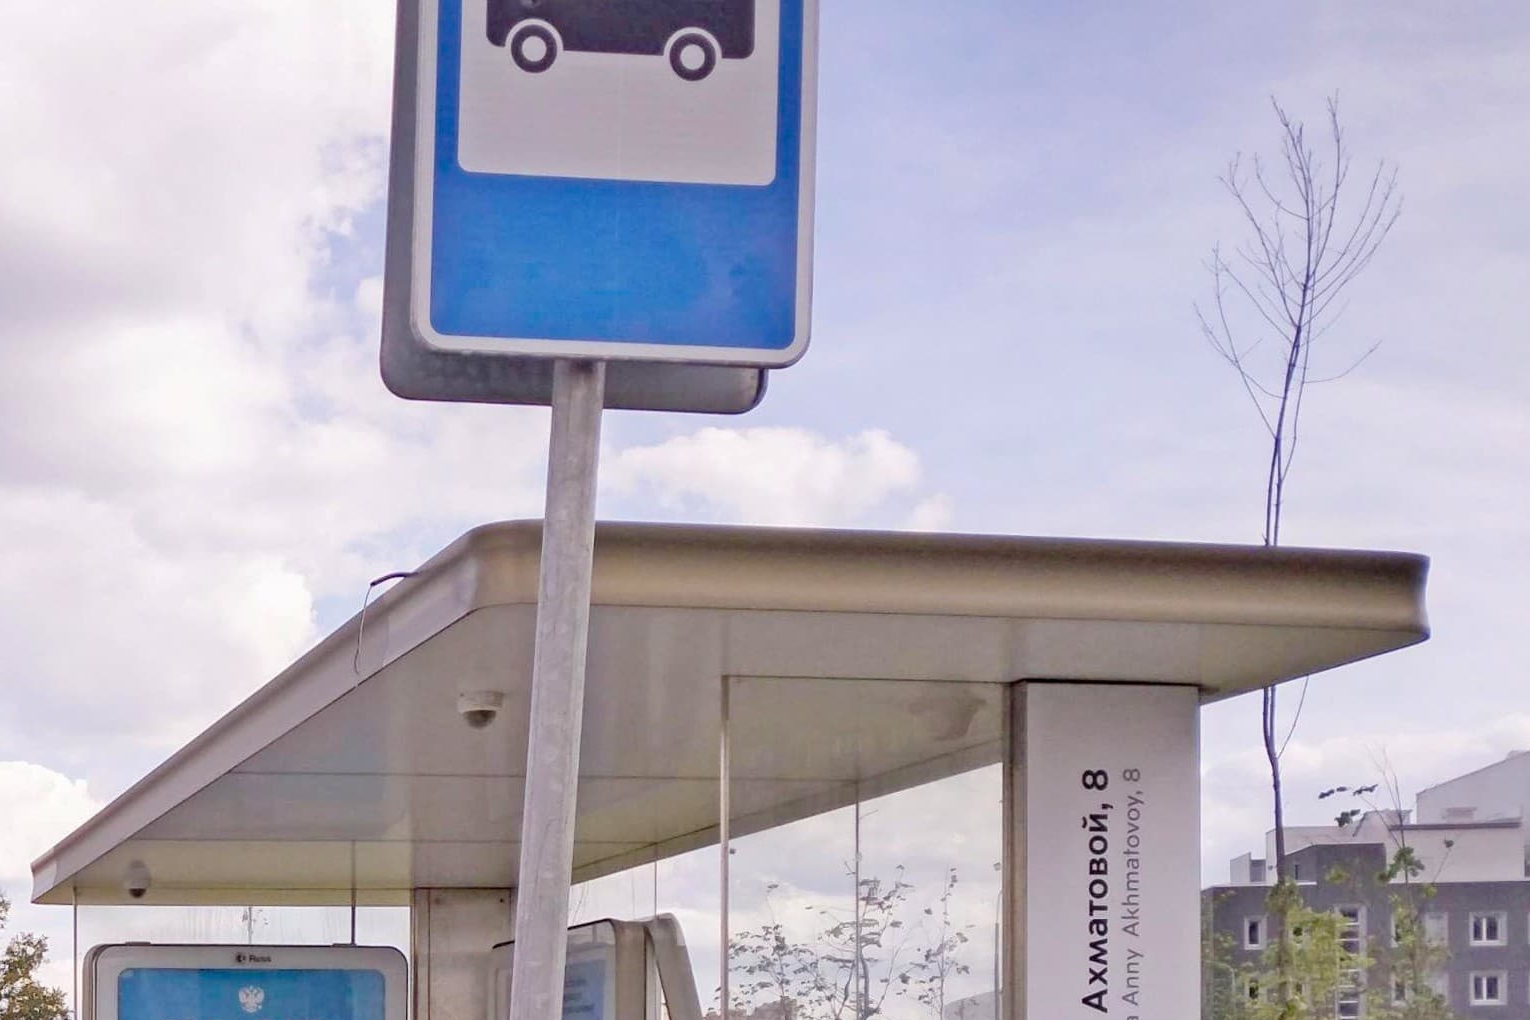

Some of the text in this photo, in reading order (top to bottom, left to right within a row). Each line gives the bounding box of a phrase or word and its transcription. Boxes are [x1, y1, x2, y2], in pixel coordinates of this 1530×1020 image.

[1082, 769, 1109, 790] 8
[1123, 768, 1141, 782] 8
[1121, 790, 1144, 937] Akhmatovoy,
[1081, 803, 1114, 1013] Ахматовой,
[1121, 948, 1144, 1006] Anny
